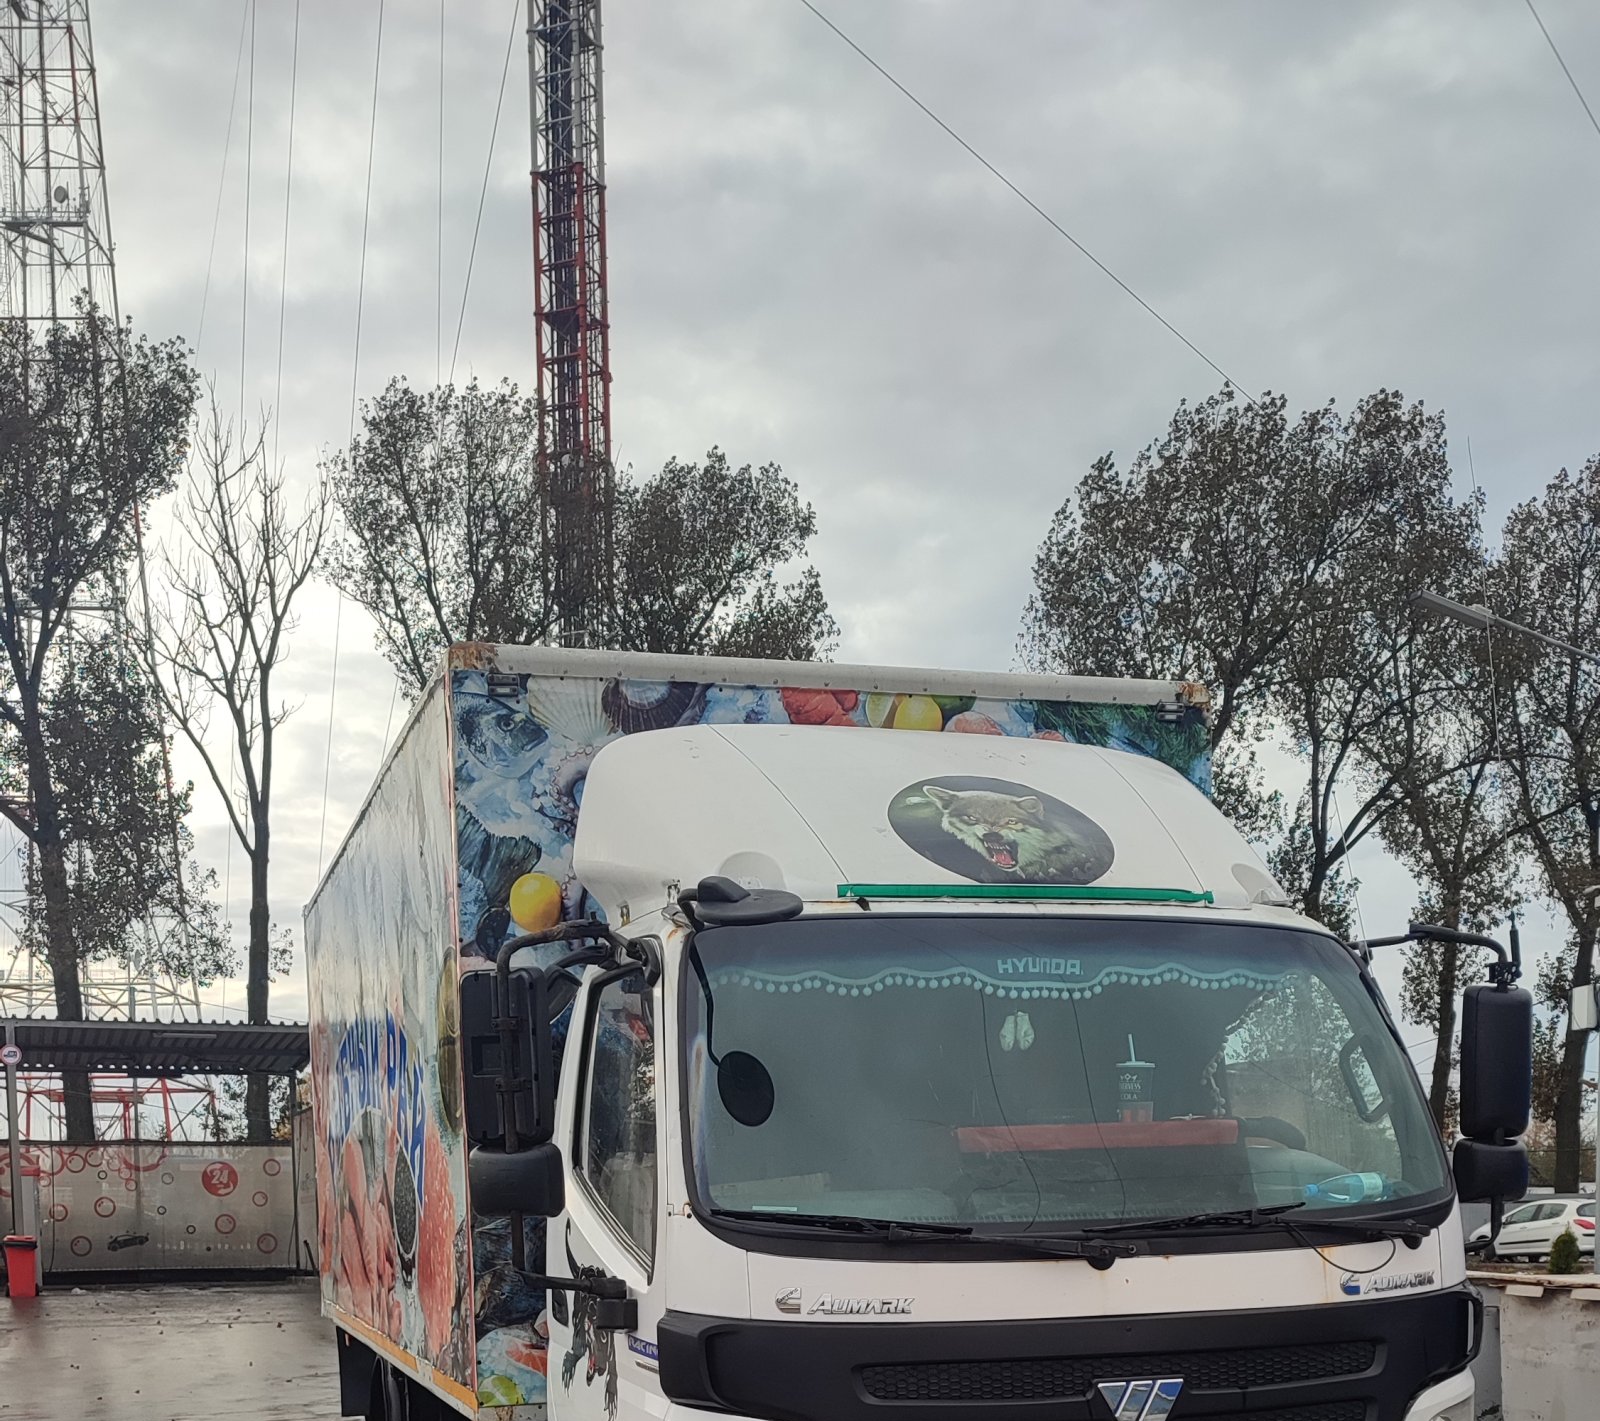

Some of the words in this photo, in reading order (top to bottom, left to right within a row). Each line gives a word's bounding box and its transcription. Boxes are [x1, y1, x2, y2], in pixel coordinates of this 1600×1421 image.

[385, 1006, 427, 1216] РАЙ
[211, 1169, 229, 1184] 24
[629, 1337, 659, 1356] RACIN
